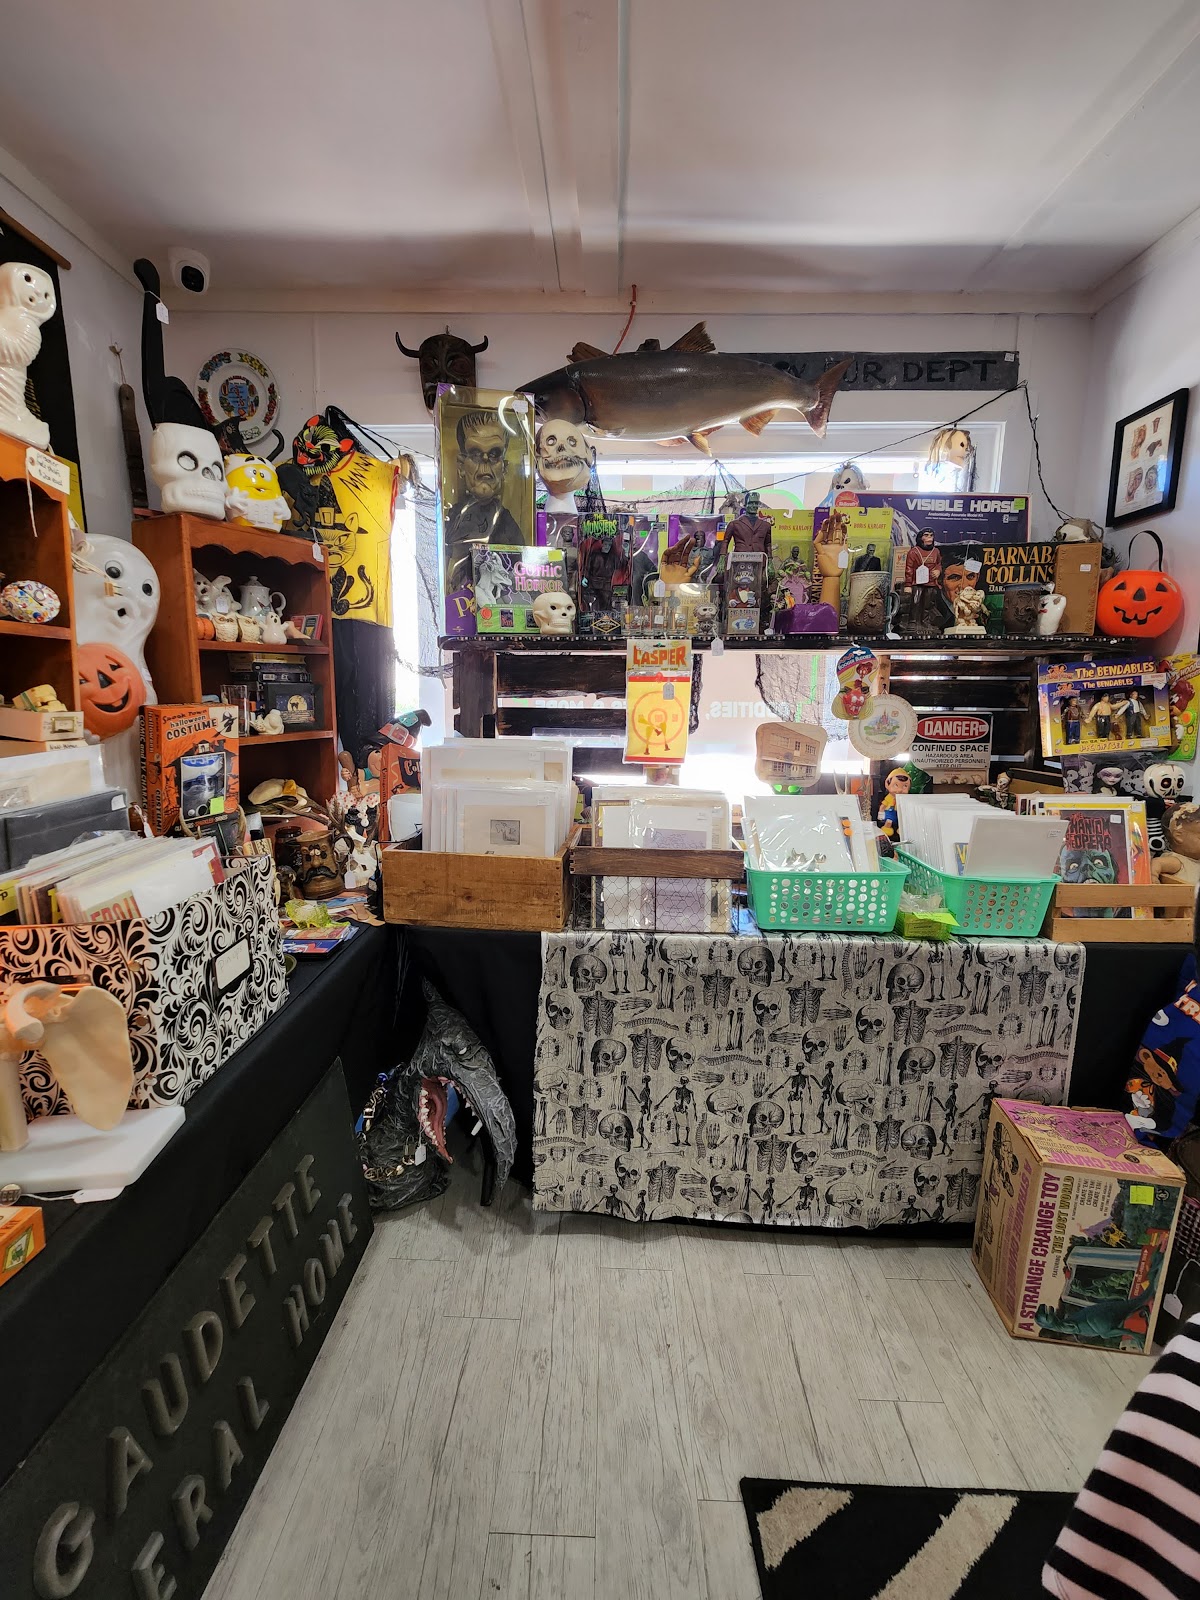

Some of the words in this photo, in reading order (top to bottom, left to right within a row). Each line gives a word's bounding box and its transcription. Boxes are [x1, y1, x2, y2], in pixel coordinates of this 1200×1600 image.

[905, 498, 963, 512] VISIBLE
[593, 513, 605, 521] THE
[581, 519, 618, 538] MUNSTERS
[983, 545, 1057, 565] BARNAB
[514, 576, 567, 593] HORROR
[988, 585, 1005, 593] DAR
[633, 644, 687, 667] CASPER
[1075, 668, 1095, 679] The
[1096, 661, 1156, 677] BENDABLES
[1083, 681, 1096, 689] The
[1096, 678, 1134, 688] BENDABLES
[166, 718, 217, 741] COSTUME
[169, 715, 206, 728] halloween
[924, 720, 980, 737] DANGER
[911, 744, 957, 752] CONFINED
[959, 744, 989, 752] SPACE
[1067, 817, 1111, 835] HANTOM
[1074, 833, 1113, 852] OPERA
[1040, 1172, 1061, 1201] TOY
[1059, 1175, 1075, 1209] WORLD
[1031, 1200, 1056, 1258] CHANGE
[1055, 1209, 1069, 1236] LOST
[1051, 1234, 1066, 1254] THE
[283, 1192, 359, 1349] HOME
[1052, 1255, 1061, 1278] FEATURING
[1019, 1258, 1047, 1320] STRANGE
[1018, 1321, 1035, 1333] A
[33, 1154, 322, 1600] GAUDETTE
